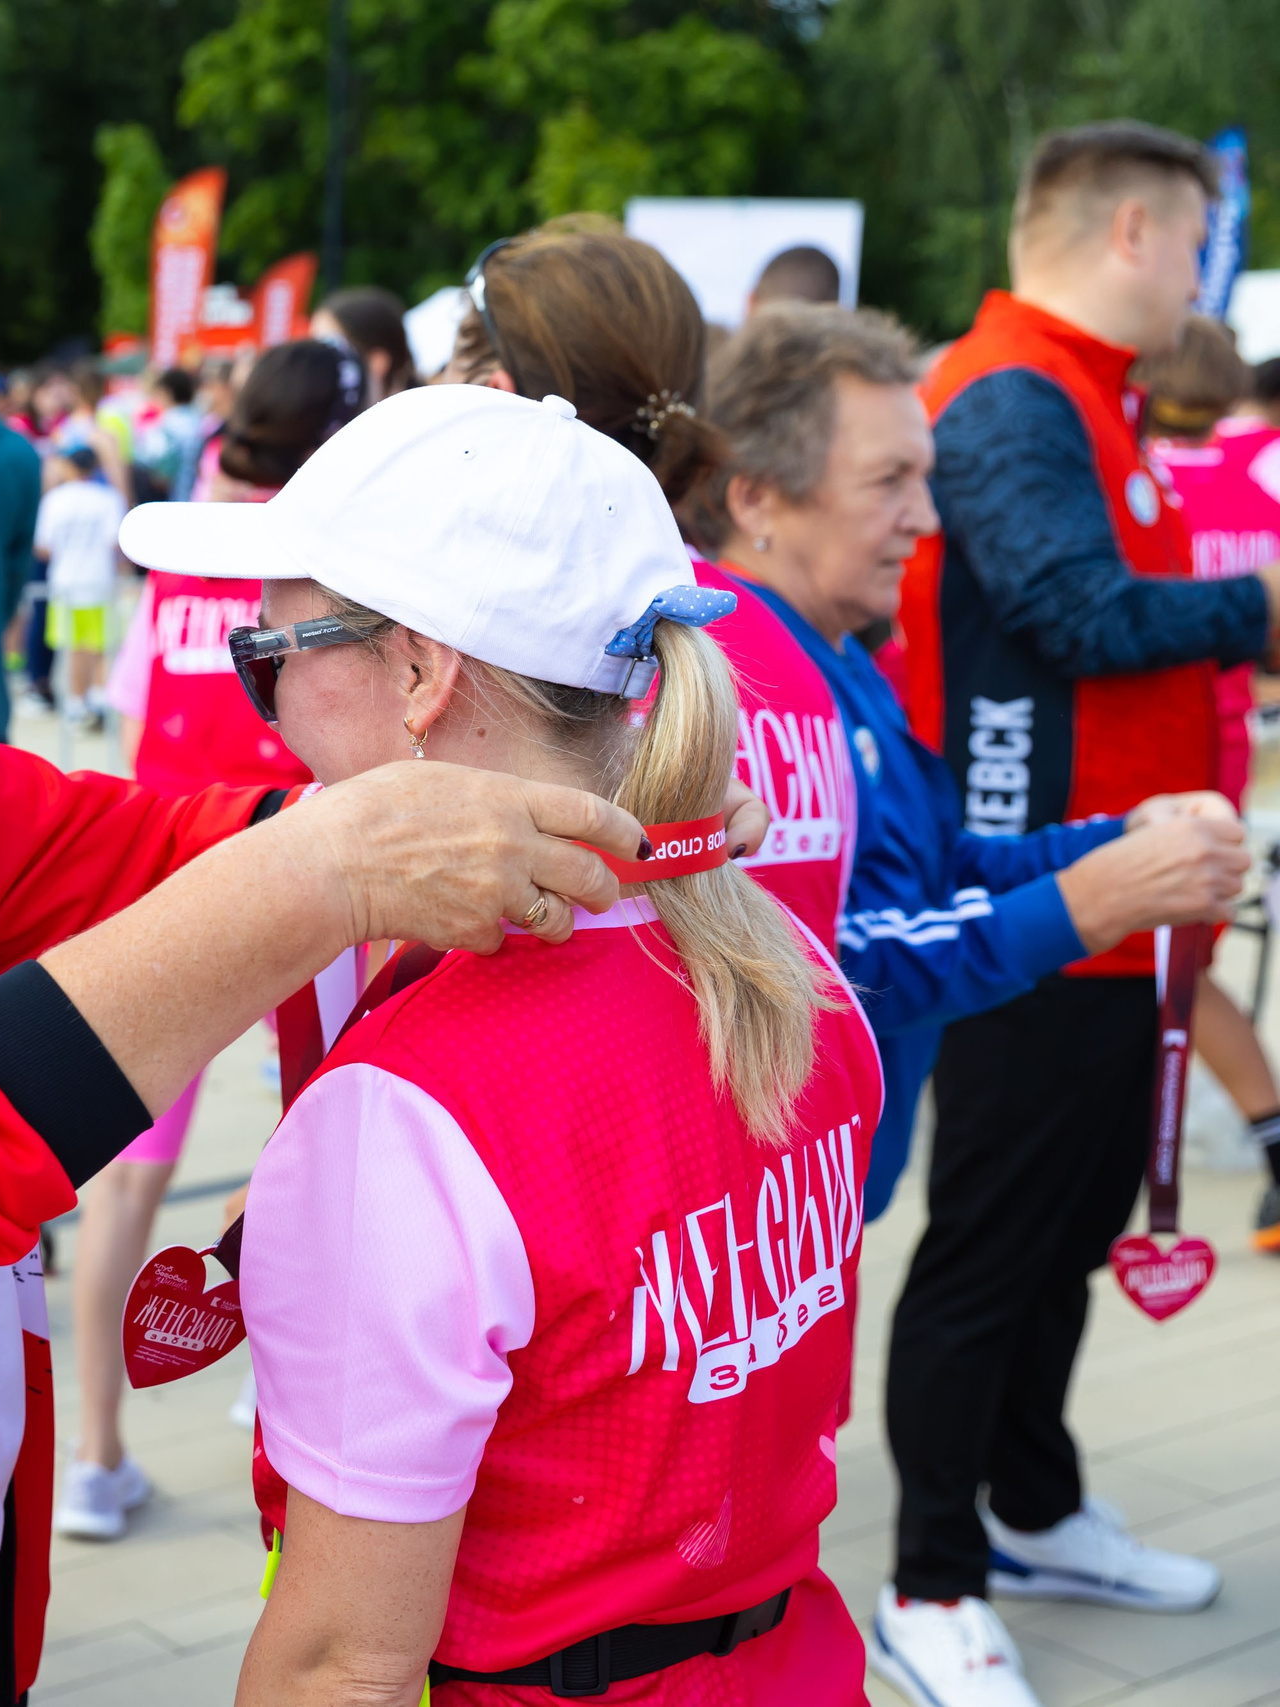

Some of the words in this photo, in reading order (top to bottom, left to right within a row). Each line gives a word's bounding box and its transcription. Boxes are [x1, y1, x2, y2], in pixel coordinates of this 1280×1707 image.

[964, 694, 1035, 836] ЕВСК
[133, 1293, 237, 1351] ЖЕНСКИЙ
[149, 1332, 199, 1350] забег
